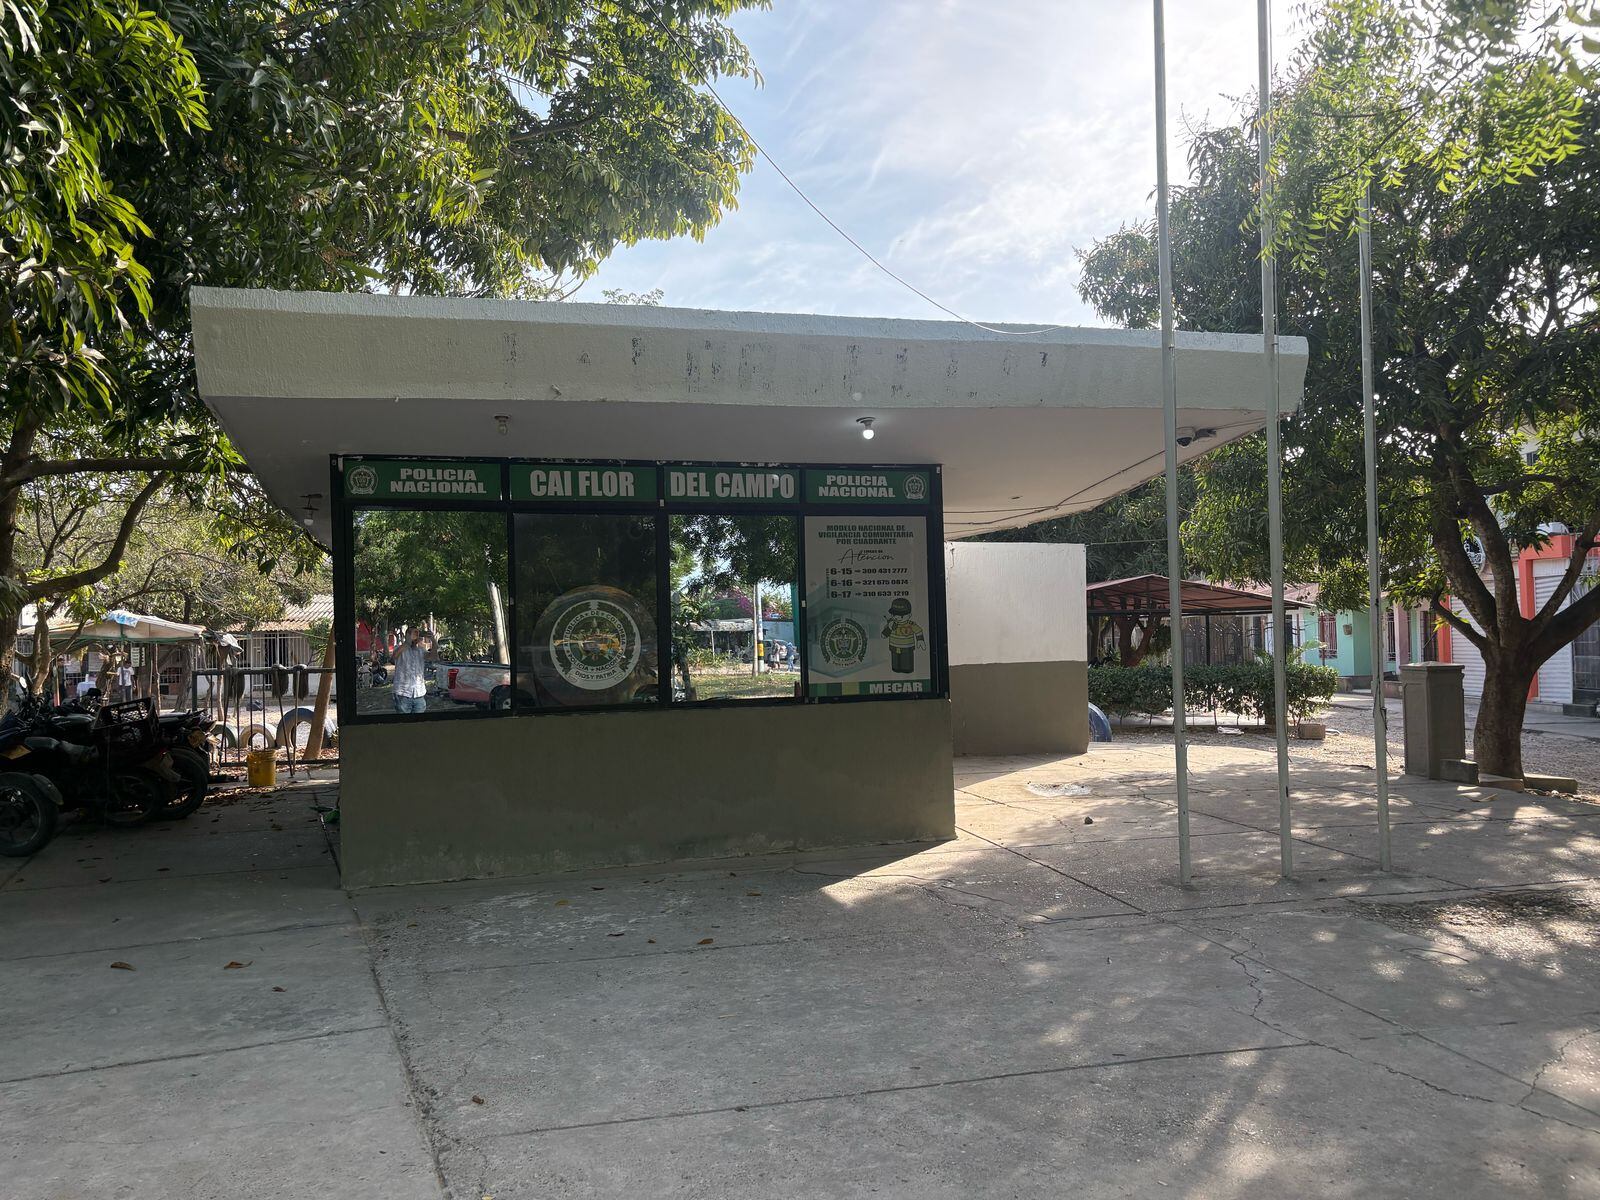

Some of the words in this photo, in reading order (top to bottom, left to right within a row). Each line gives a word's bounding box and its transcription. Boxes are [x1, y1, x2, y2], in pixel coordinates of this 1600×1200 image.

[400, 468, 477, 481] POLICIA
[826, 475, 888, 486] POLICIA
[390, 481, 487, 494] NACIONAL
[530, 470, 572, 497] CAI
[577, 471, 635, 497] FLOR
[670, 472, 710, 497] DEL
[715, 472, 795, 498] CAMPO
[818, 486, 896, 498] NACIONAL
[869, 682, 923, 694] MECAR
